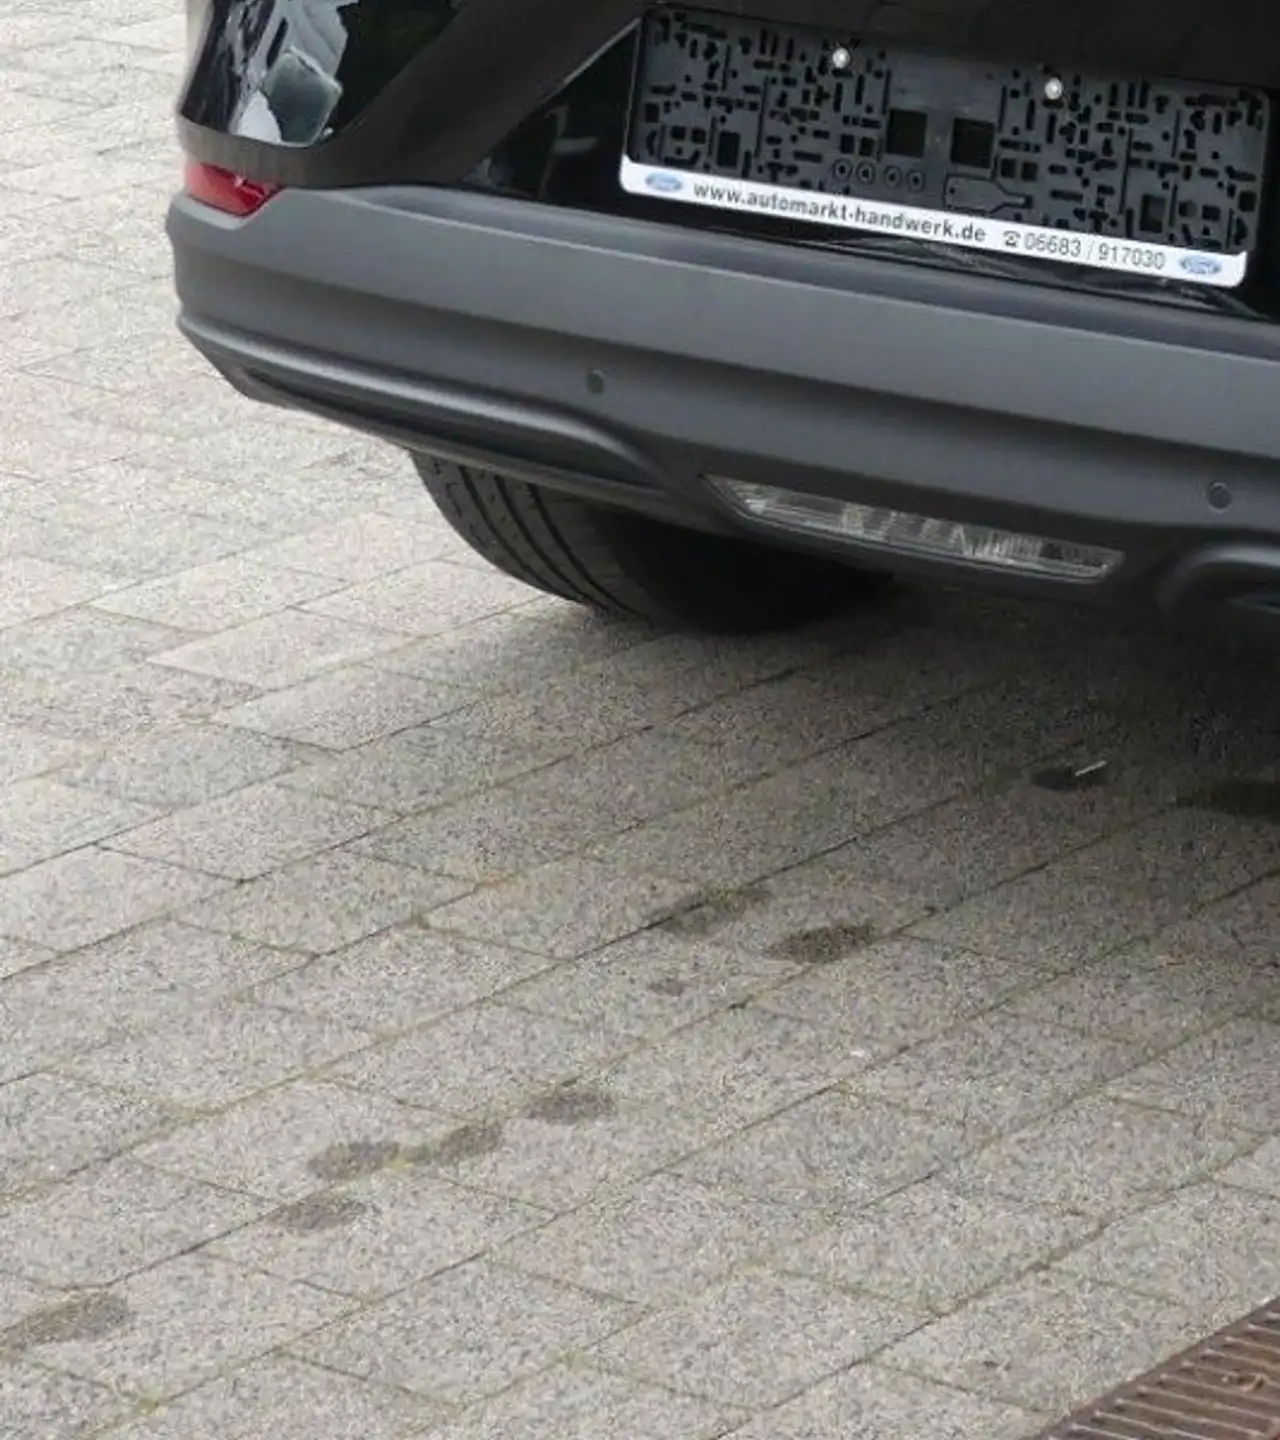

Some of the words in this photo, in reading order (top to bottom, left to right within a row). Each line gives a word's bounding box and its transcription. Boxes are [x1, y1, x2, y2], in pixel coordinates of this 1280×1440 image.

[692, 180, 988, 243] www.automarkt-handwerk.de
[1023, 231, 1082, 258] 06683
[1098, 241, 1166, 271] 917030
